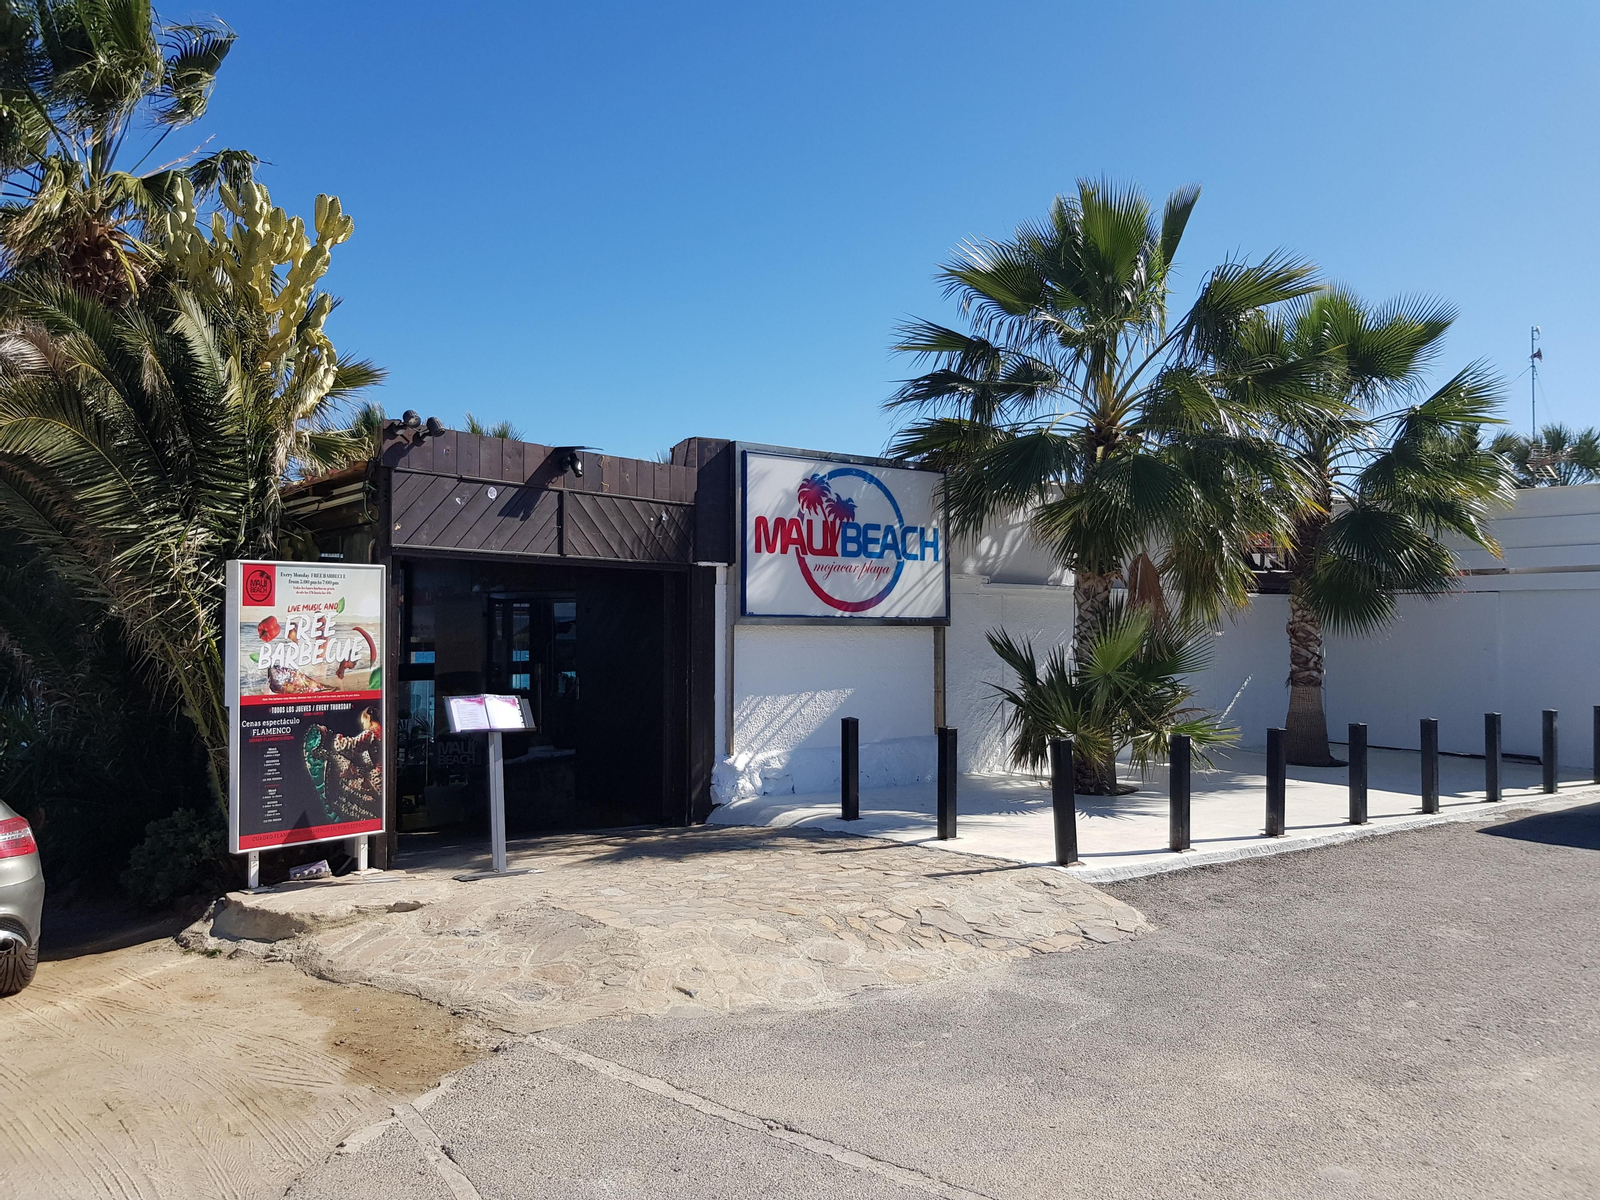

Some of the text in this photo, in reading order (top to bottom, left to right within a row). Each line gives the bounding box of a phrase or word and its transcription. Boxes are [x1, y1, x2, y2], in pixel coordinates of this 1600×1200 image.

[754, 516, 939, 562] MAUI BEACH
[813, 560, 890, 582] mojacar playa
[250, 579, 268, 587] MAUI
[302, 603, 322, 611] MUSIC
[284, 612, 340, 640] FREE
[258, 637, 365, 670] BARBECUE
[262, 717, 300, 727] espectáculo
[252, 727, 291, 736] FLAMENCO
[438, 755, 475, 764] BEACH
